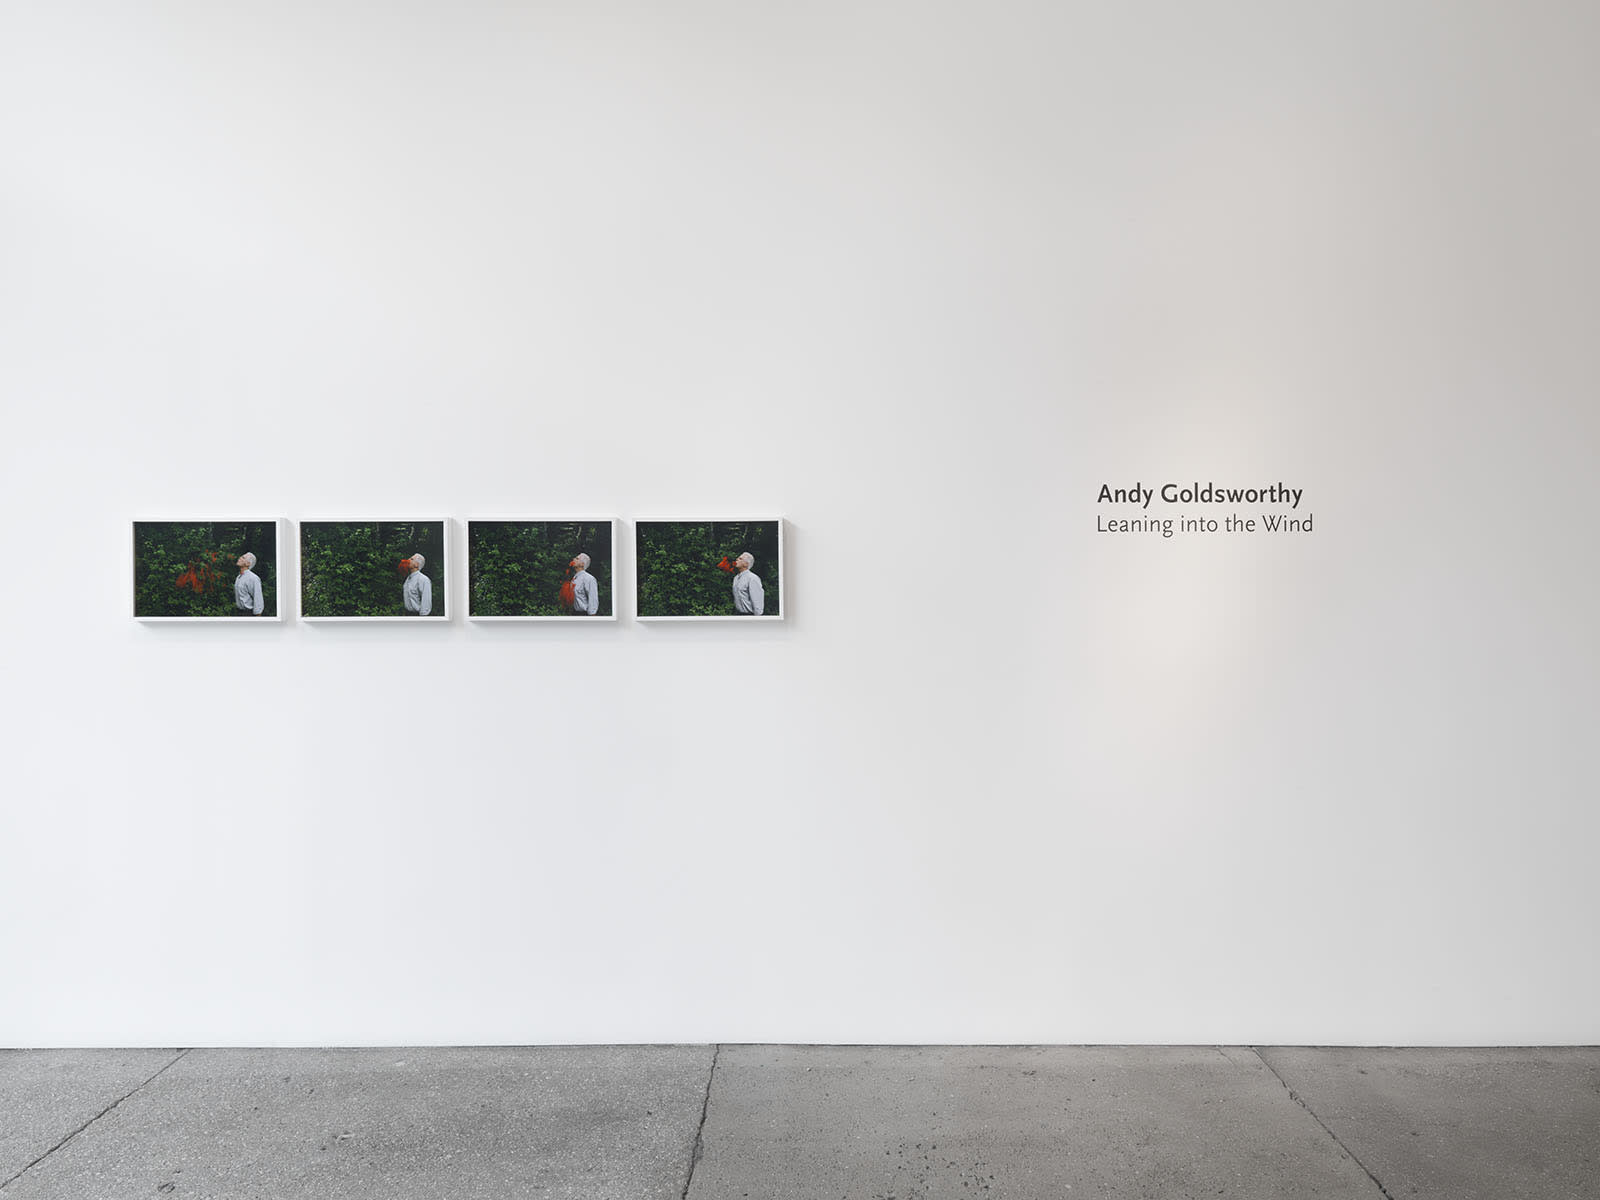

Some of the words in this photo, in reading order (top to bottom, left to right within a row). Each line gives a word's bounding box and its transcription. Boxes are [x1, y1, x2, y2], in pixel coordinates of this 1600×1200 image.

[1097, 482, 1153, 509] Andy
[1161, 482, 1303, 509] Goldsworthy
[1097, 515, 1174, 538] Leaning
[1181, 515, 1218, 532] into
[1225, 513, 1256, 532] the
[1262, 513, 1313, 532] Wind
